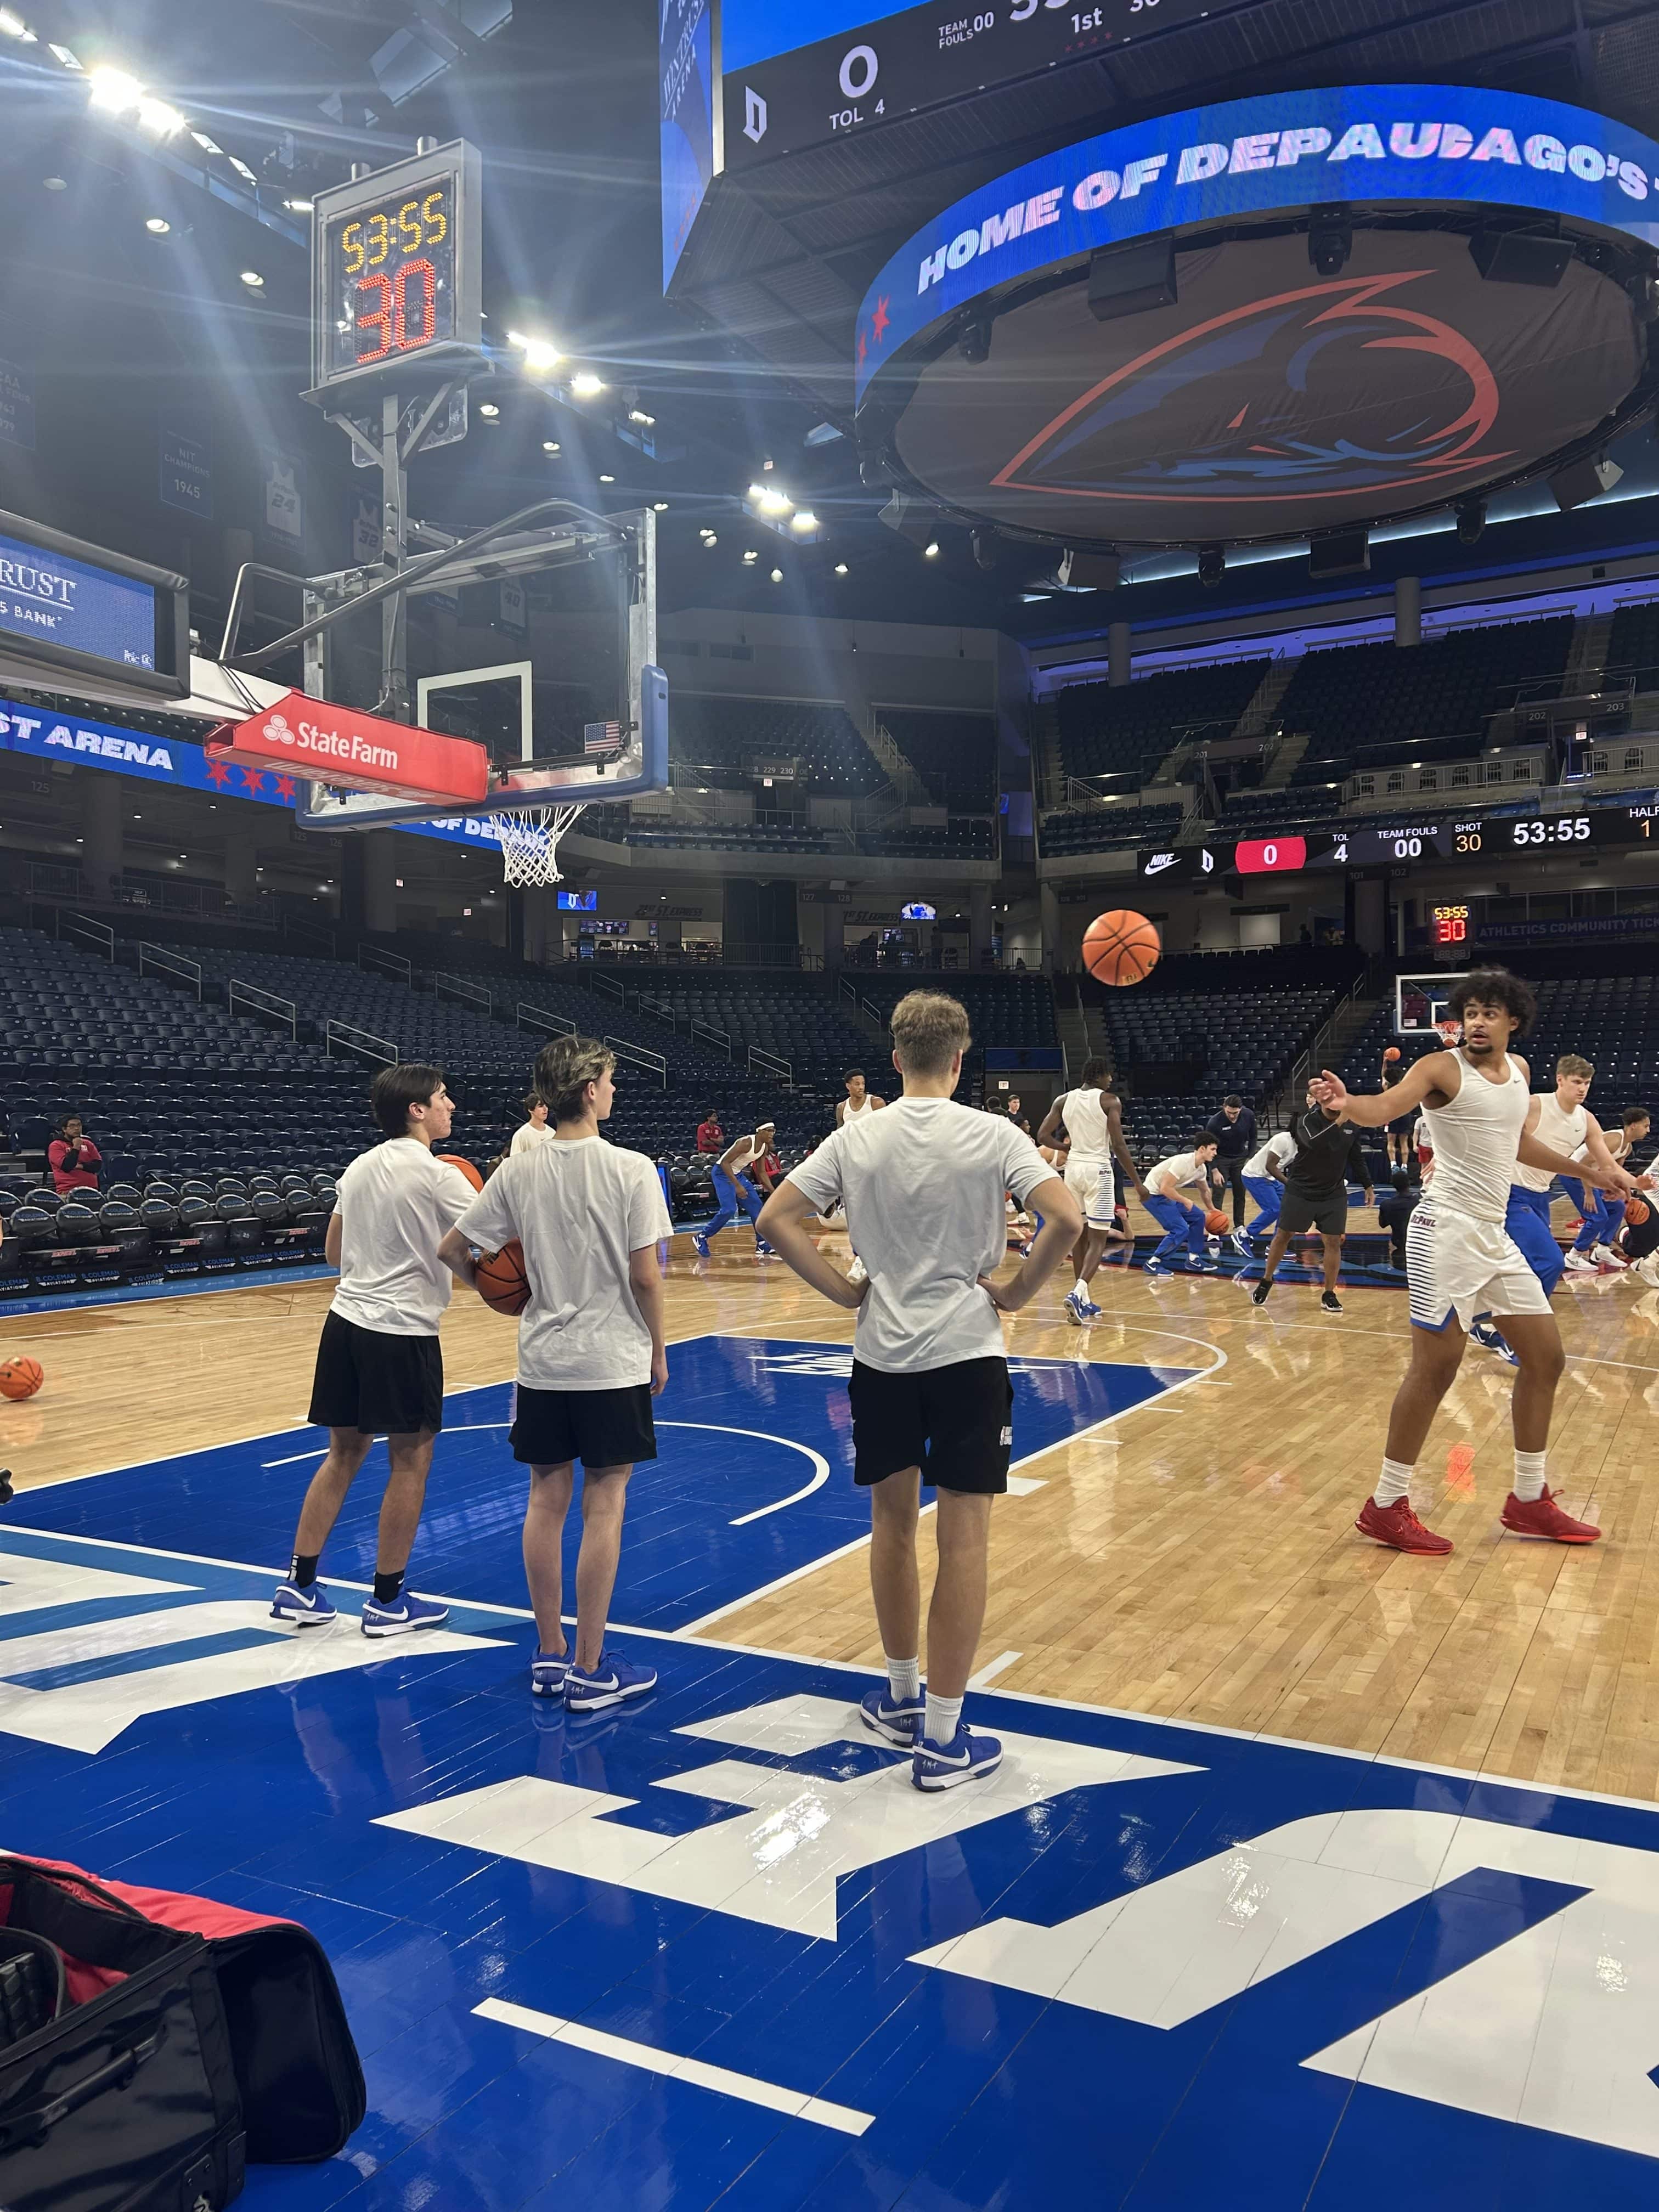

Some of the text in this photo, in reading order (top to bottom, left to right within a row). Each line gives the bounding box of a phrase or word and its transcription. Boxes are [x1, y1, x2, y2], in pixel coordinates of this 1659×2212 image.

[939, 19, 968, 37] TEAM
[973, 11, 995, 32] 00
[1071, 7, 1103, 33] 1st
[939, 29, 974, 49] FOULS
[830, 99, 885, 131] TOL 4
[342, 191, 447, 273] 53:55
[917, 185, 1064, 295] HOME
[1073, 154, 1168, 211] OF
[357, 258, 435, 364] 30
[179, 447, 195, 462] NIT
[165, 454, 211, 478] CHAMPIONS
[174, 479, 201, 499] 1945
[270, 493, 296, 514] 24
[358, 531, 379, 548] 32
[1528, 712, 1547, 721] 202
[1606, 702, 1624, 712] 203
[43, 725, 174, 771] ARENA
[31, 781, 49, 794] 125
[1333, 833, 1350, 842] TOL
[1377, 826, 1438, 840] TEAM FOULS
[1454, 822, 1482, 833] SHOT
[1513, 817, 1591, 845] 53:55
[1641, 819, 1651, 839] 1
[1334, 844, 1348, 862] 4
[1394, 838, 1423, 859] 00
[1456, 833, 1482, 853] 30
[1150, 853, 1175, 867] NIKE
[1263, 844, 1278, 866] 0
[1350, 867, 1407, 880] 101 102
[802, 893, 850, 903] 127 128
[1434, 905, 1469, 920] 53:55
[1439, 919, 1466, 942] 30
[1480, 924, 1547, 938] ATHLETICS
[1550, 919, 1629, 933] COMMUNITY
